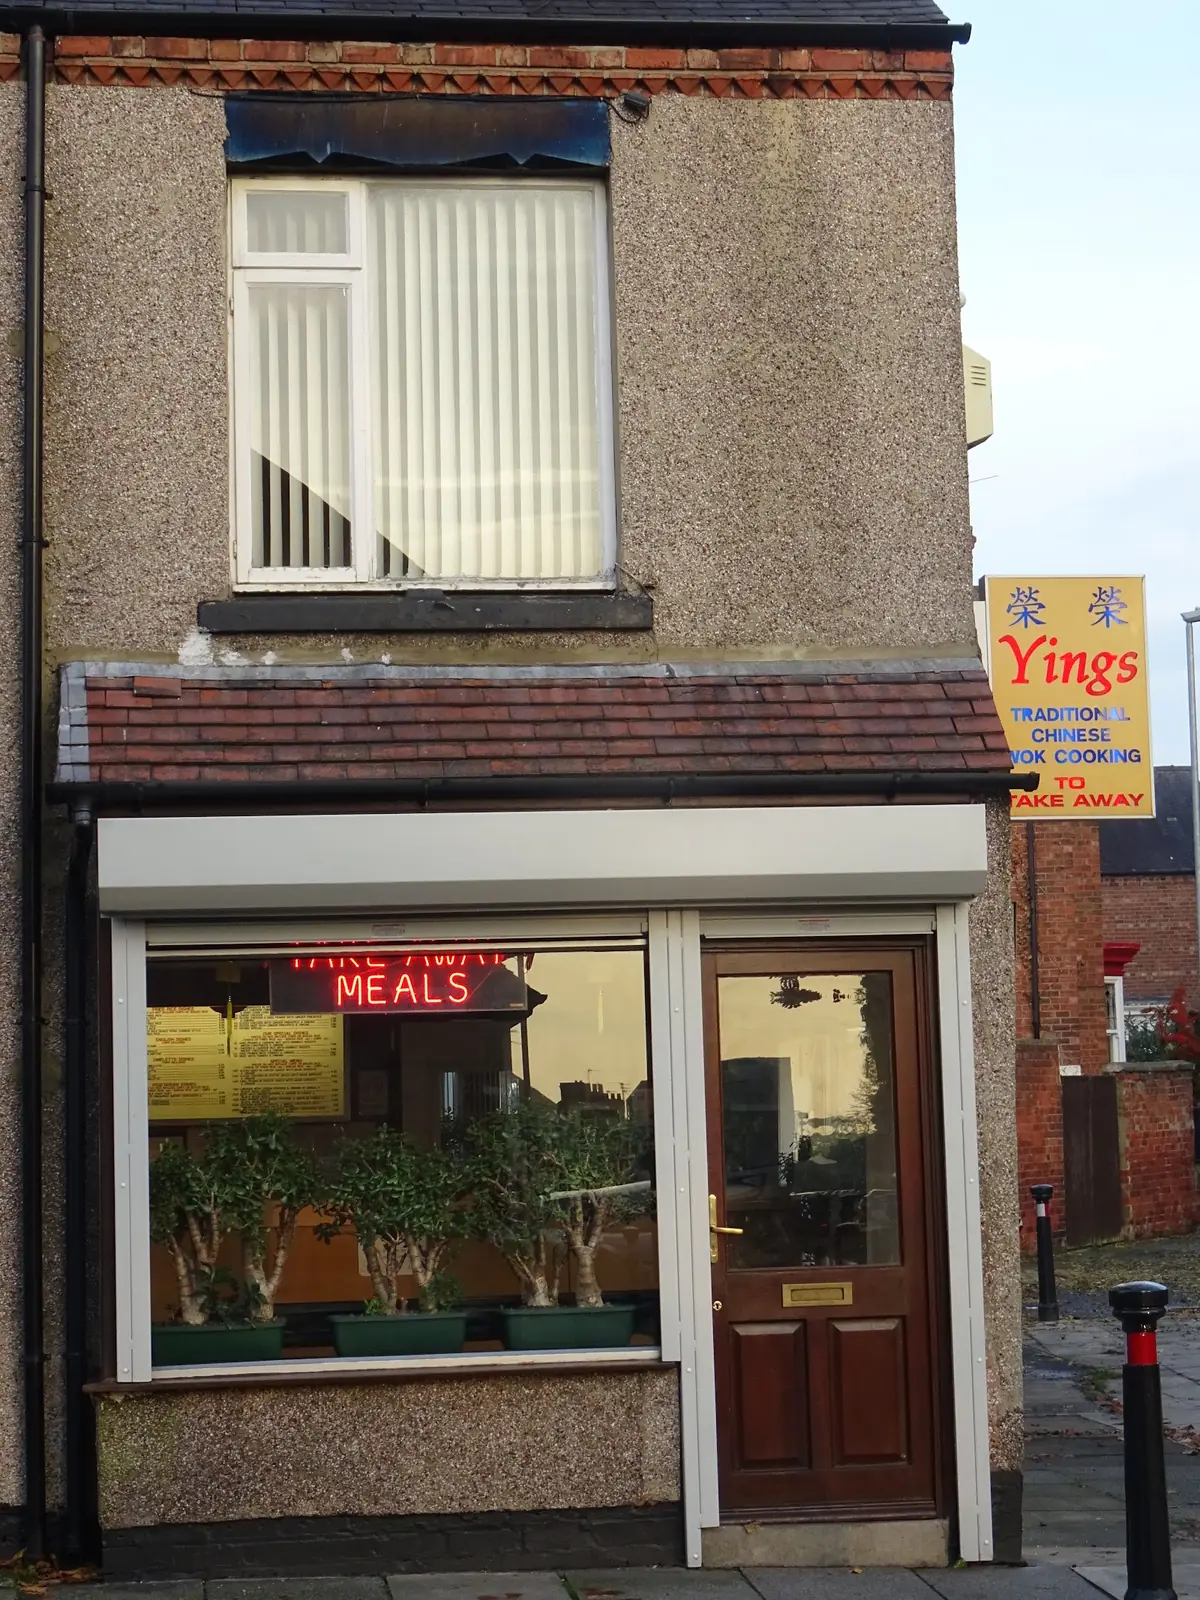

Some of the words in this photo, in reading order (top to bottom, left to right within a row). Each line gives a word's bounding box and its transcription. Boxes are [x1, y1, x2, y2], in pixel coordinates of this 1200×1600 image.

[1006, 586, 1046, 629] 榮
[1088, 586, 1128, 629] 榮
[998, 634, 1139, 696] Yings
[1010, 706, 1131, 723] TRADITIONAL
[1031, 728, 1111, 743] CHINESE
[1054, 749, 1141, 764] COOKING
[1054, 776, 1086, 790] TO
[1073, 793, 1145, 808] AWAY
[337, 972, 469, 1006] MEALS
